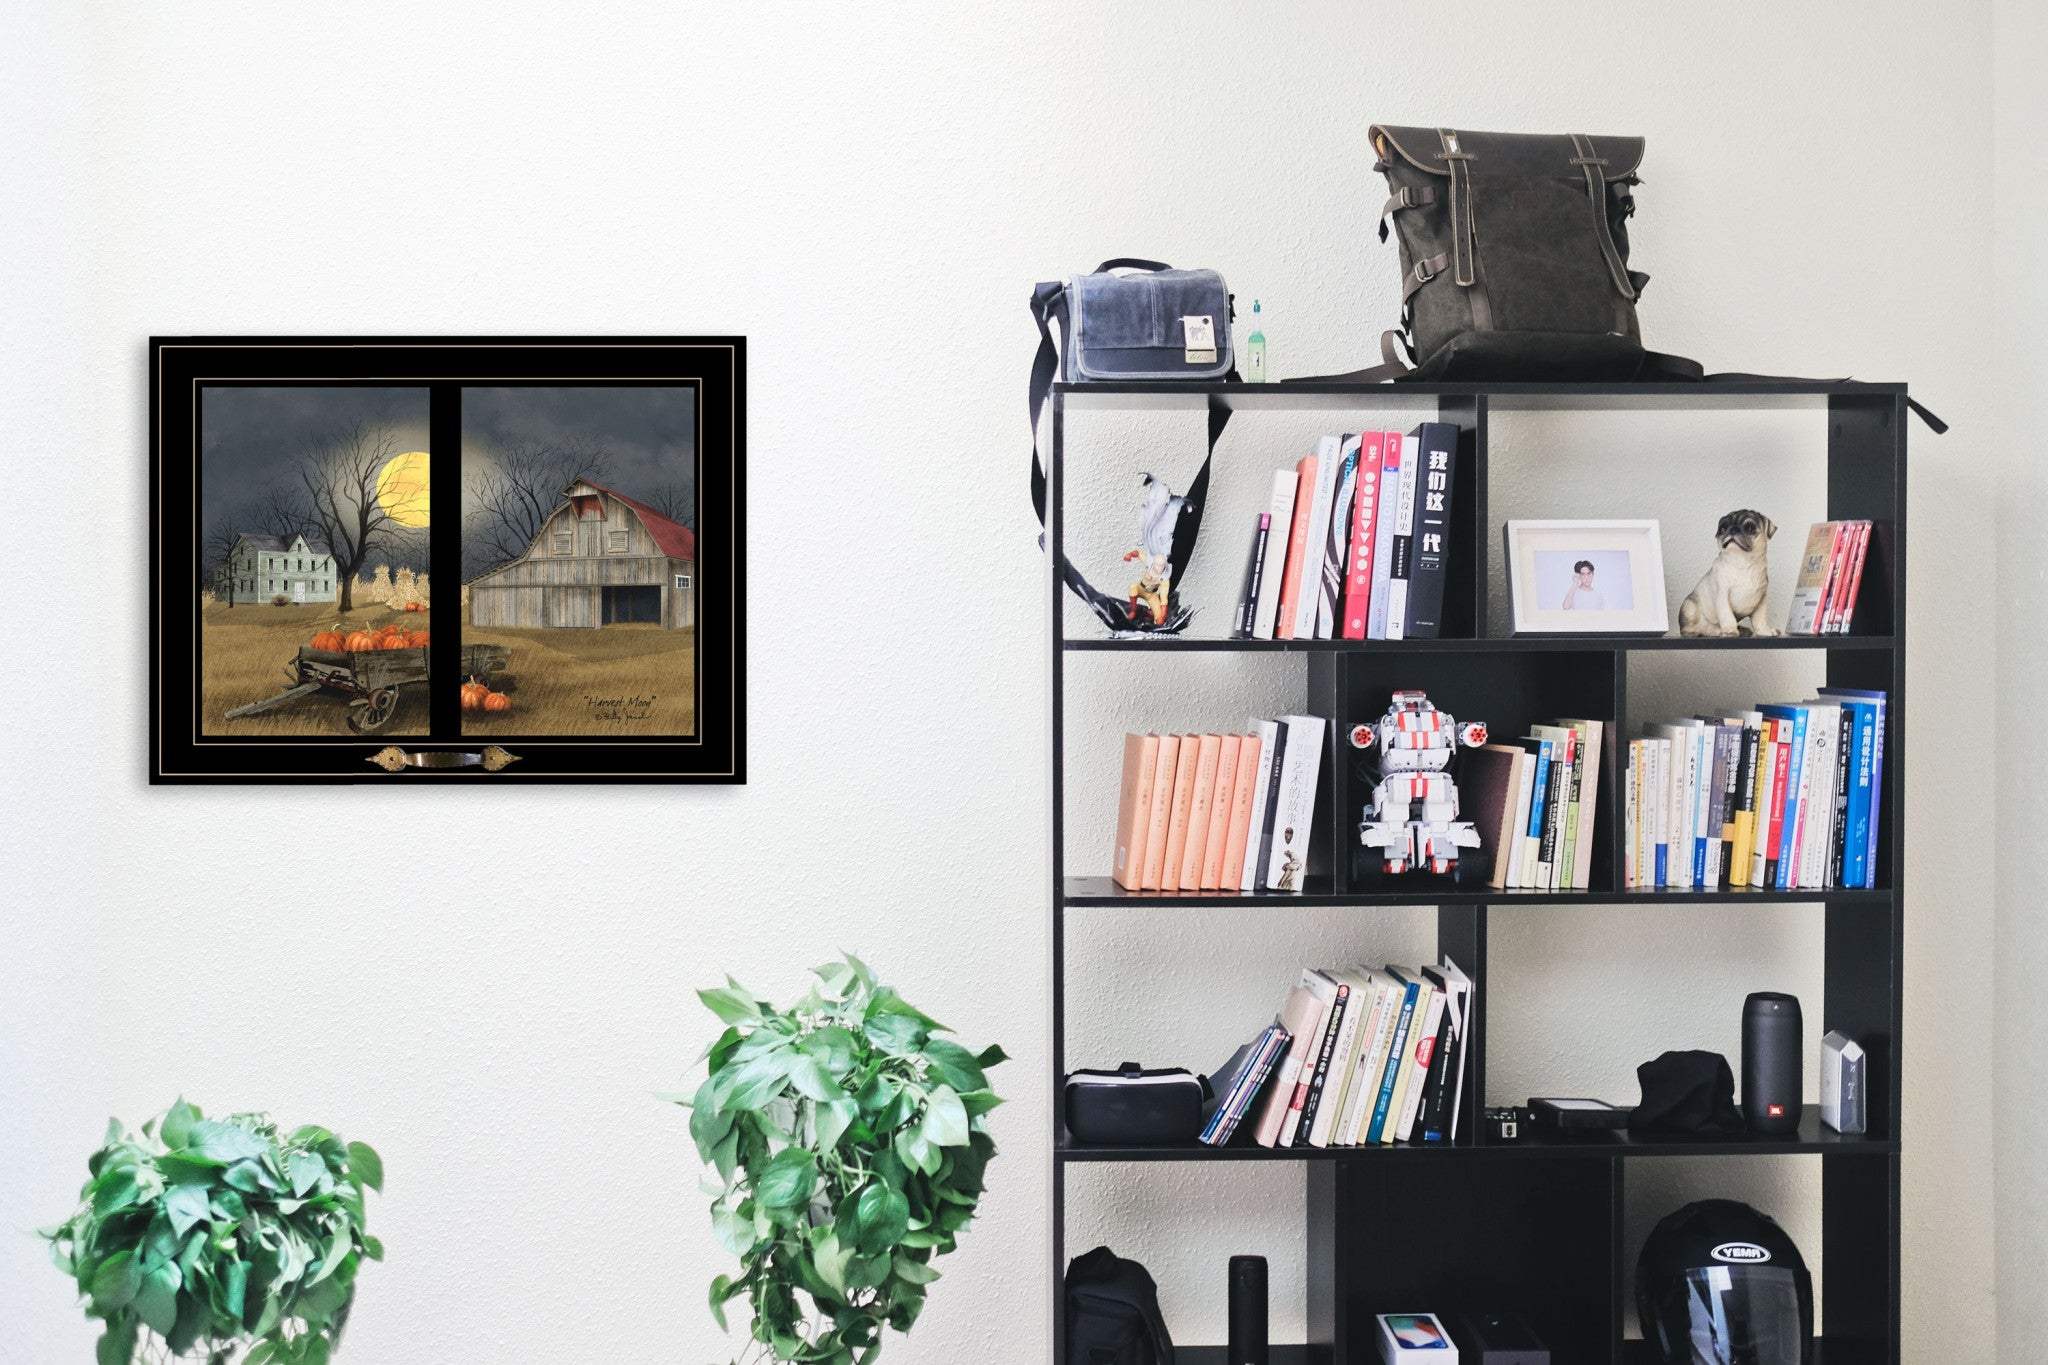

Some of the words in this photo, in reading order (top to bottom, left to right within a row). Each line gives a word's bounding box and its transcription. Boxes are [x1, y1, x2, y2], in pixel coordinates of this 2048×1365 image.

[1423, 450, 1448, 552] 我们这一代
